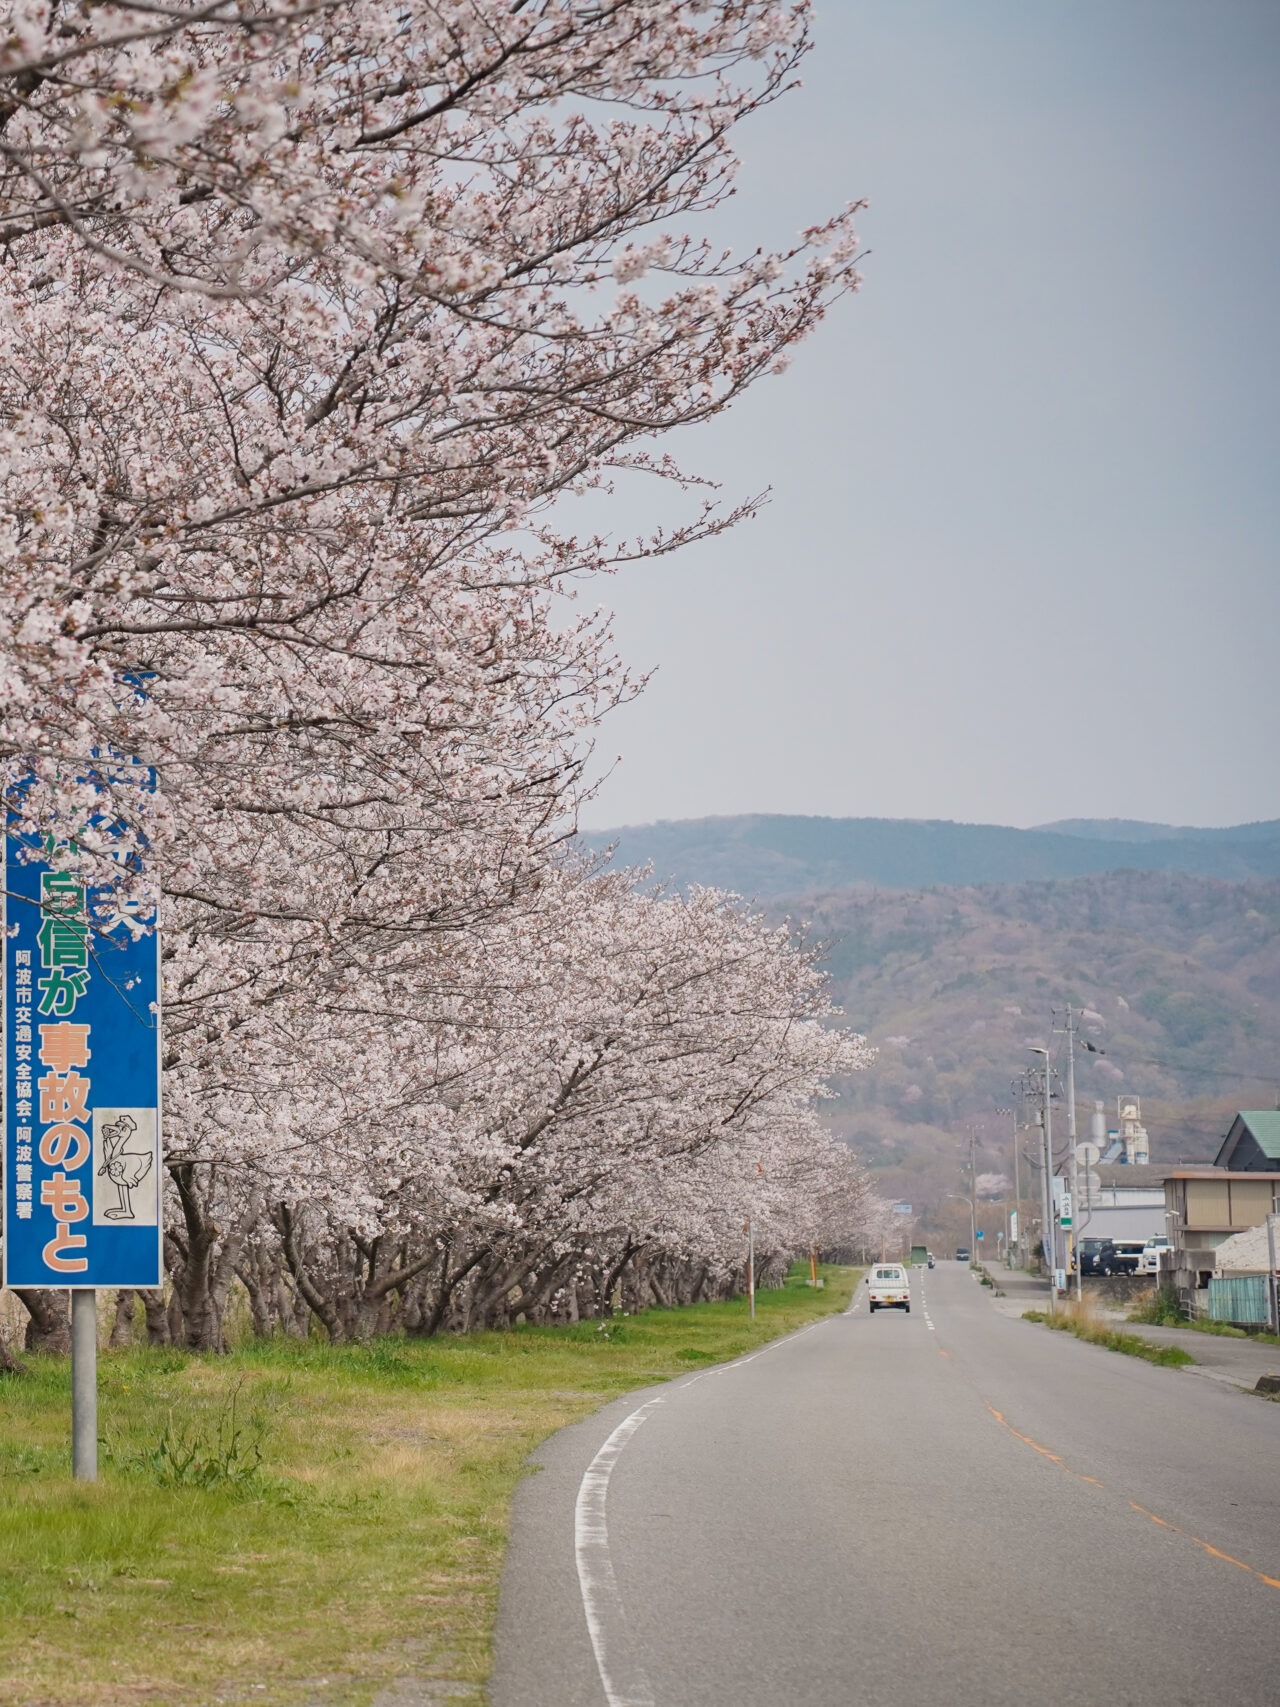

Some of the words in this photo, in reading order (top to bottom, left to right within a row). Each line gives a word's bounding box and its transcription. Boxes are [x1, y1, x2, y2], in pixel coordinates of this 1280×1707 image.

[15, 949, 33, 1220] 阿波市交通安全協会・阿波警察署
